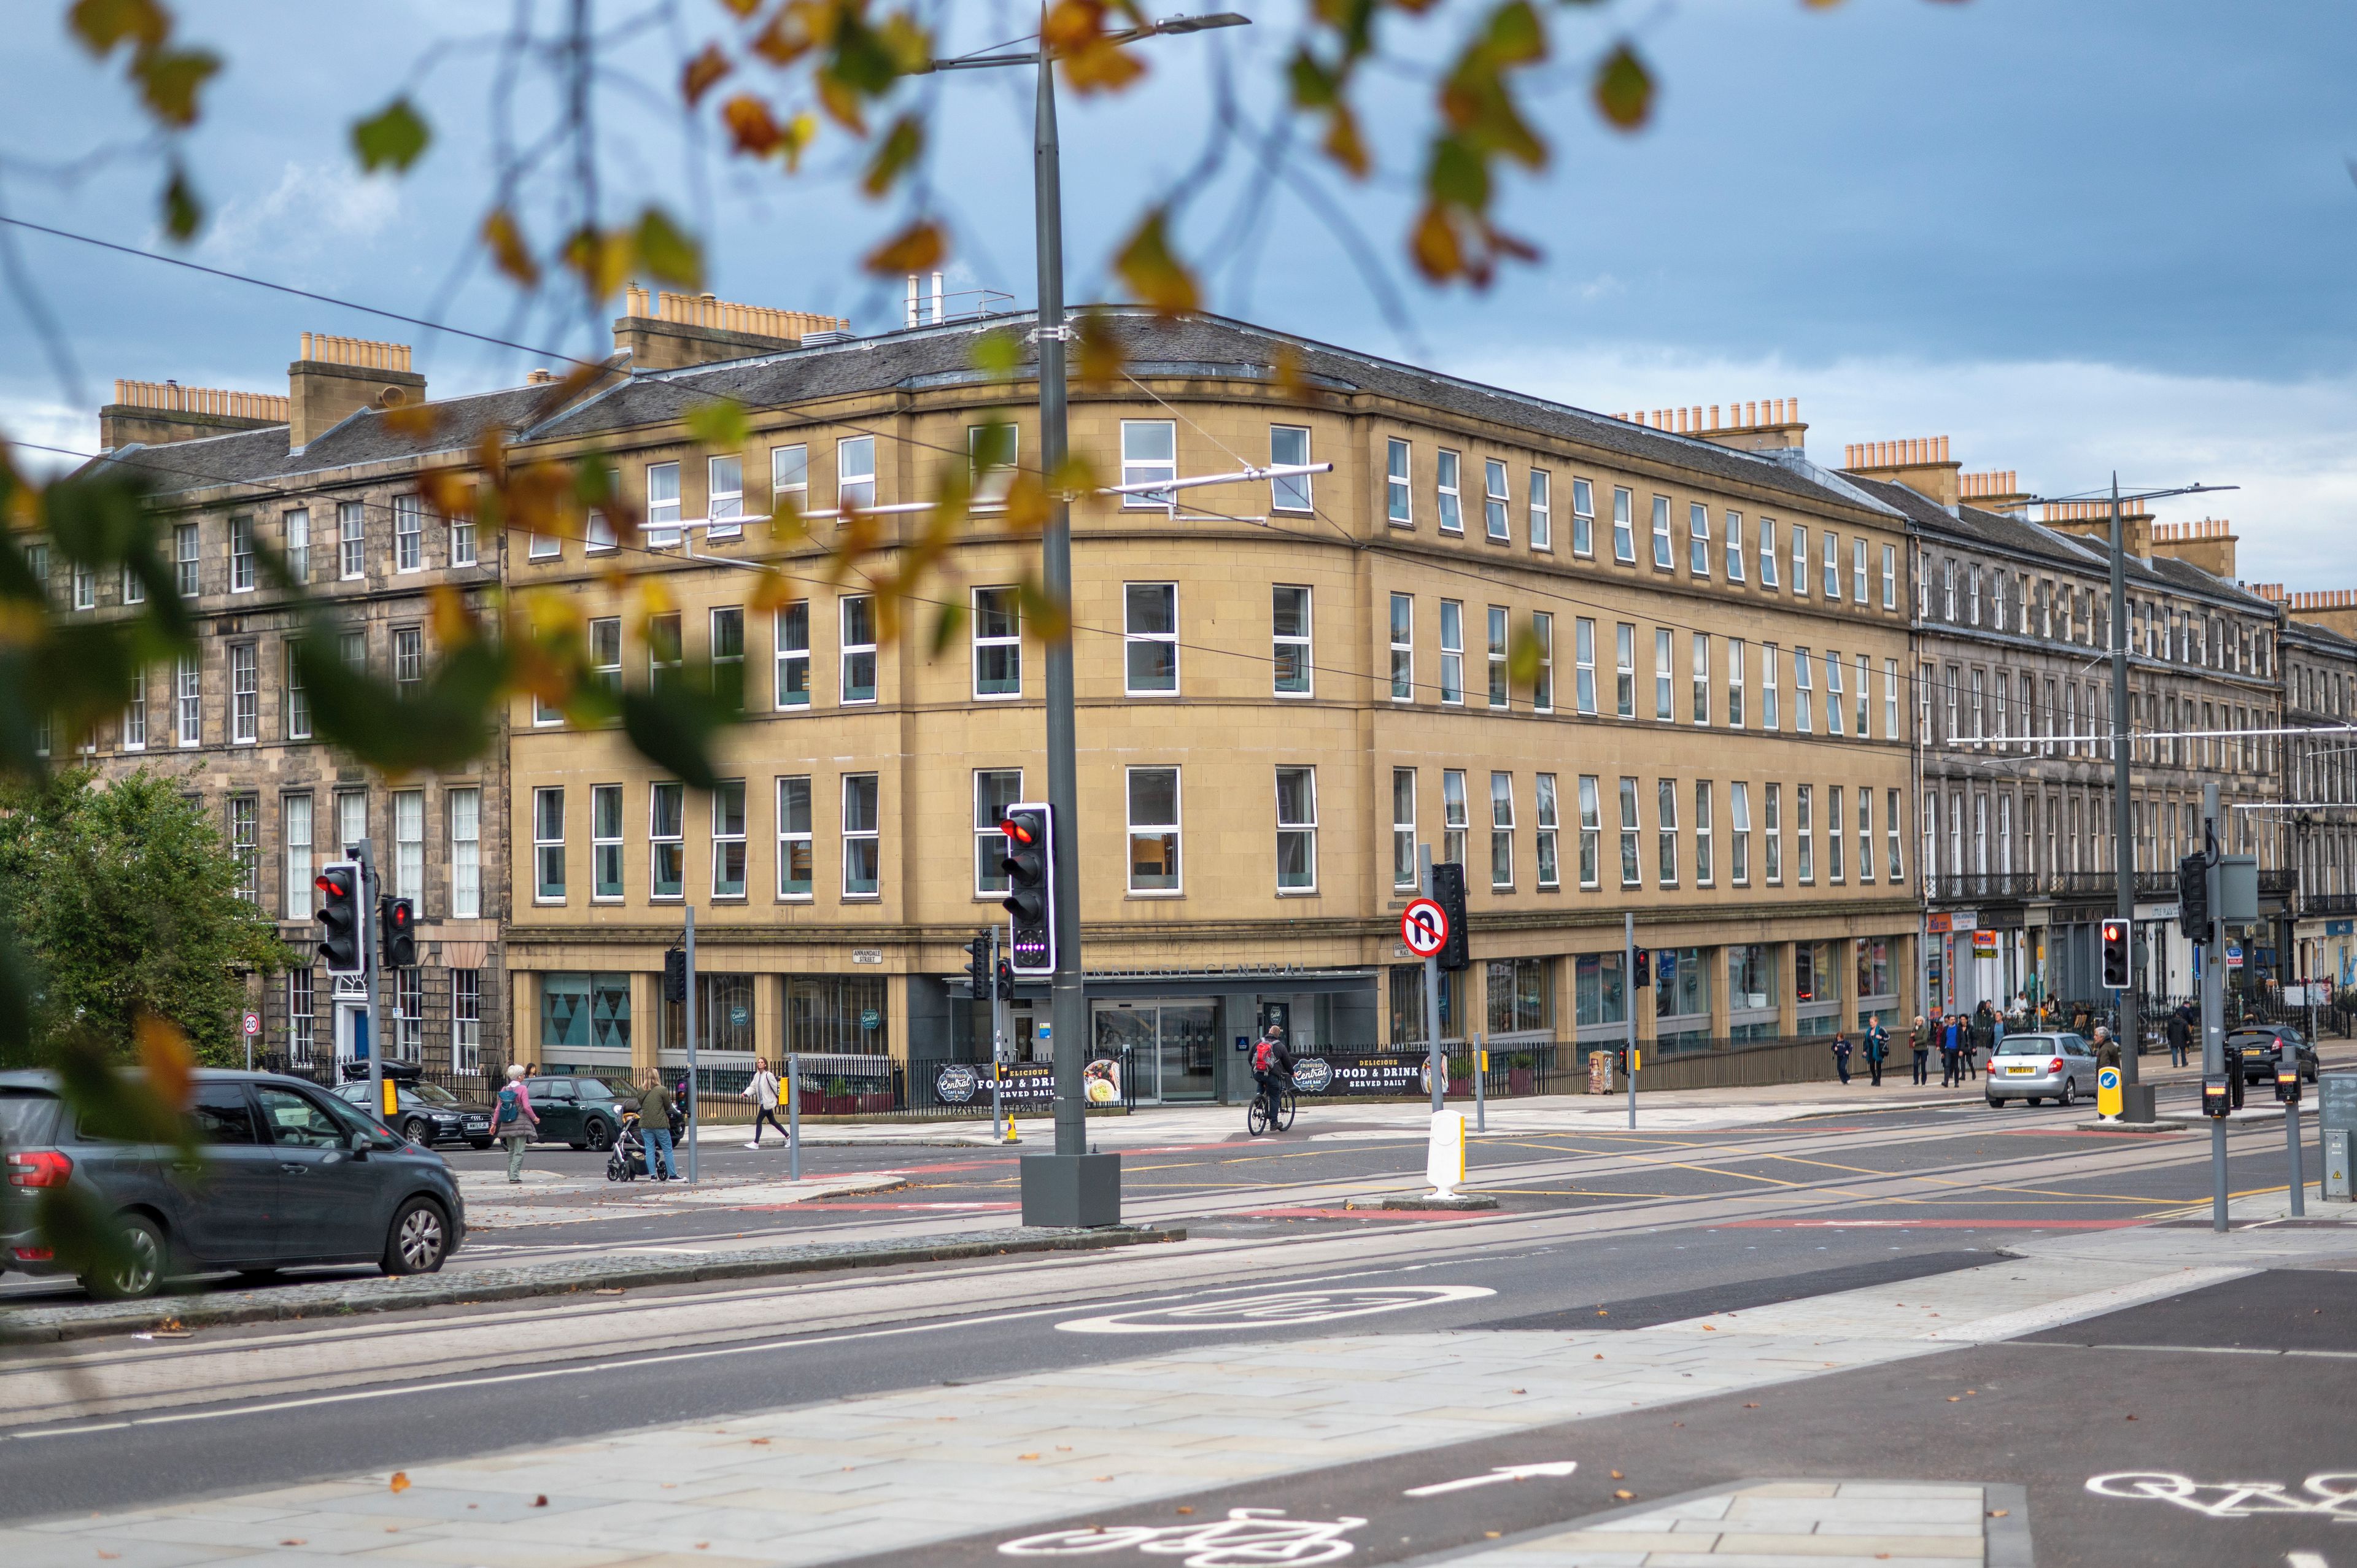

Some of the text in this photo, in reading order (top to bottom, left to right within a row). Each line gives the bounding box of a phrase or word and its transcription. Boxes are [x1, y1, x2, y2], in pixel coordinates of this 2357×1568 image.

[1930, 917, 1939, 930] Ria
[1204, 962, 1309, 977] CENTRAL
[862, 1014, 878, 1022] Central
[1295, 1066, 1328, 1081] Central
[1334, 1067, 1418, 1078] FOOD & DRINK
[940, 1076, 970, 1091] Central
[1018, 1079, 1026, 1088] &
